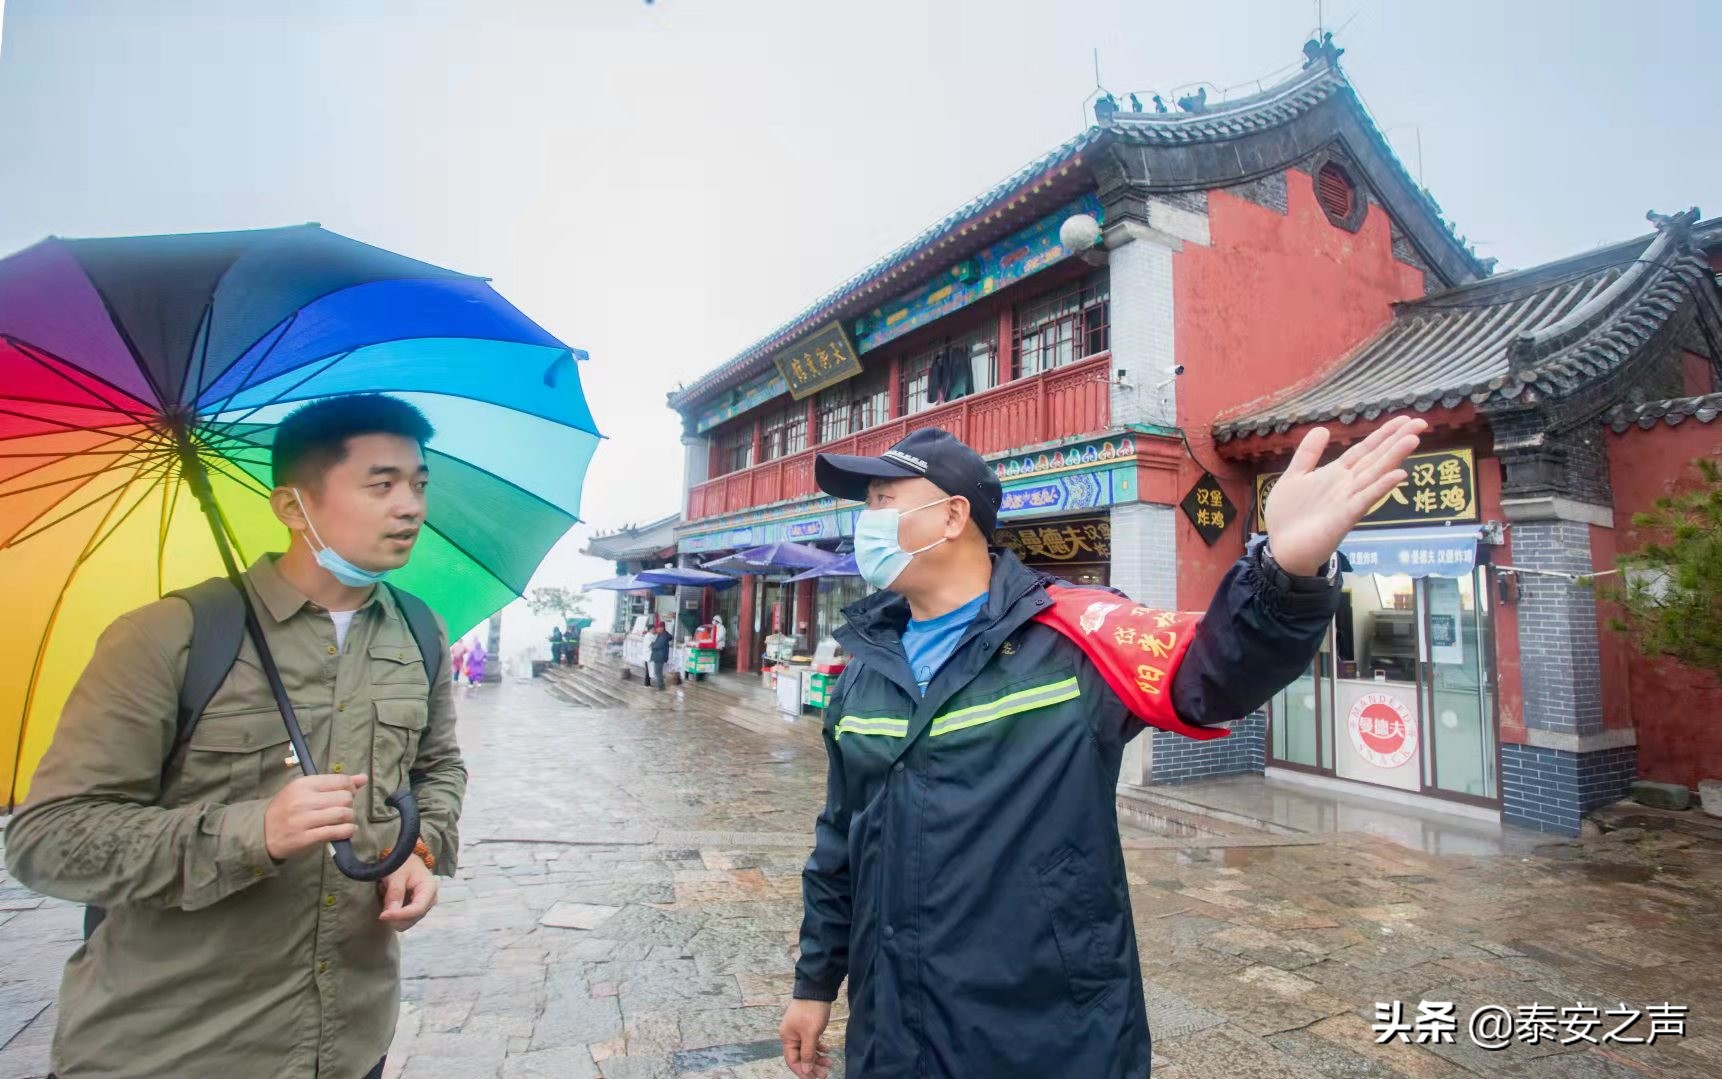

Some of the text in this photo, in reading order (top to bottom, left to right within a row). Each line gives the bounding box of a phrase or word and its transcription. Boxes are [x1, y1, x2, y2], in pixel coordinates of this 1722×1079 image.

[1412, 458, 1462, 486] 汉堡
[1196, 487, 1224, 507] 汉堡
[1413, 485, 1465, 514] 炸鸡
[1196, 509, 1225, 529] 炸鸡
[1019, 528, 1092, 560] 曼德夫
[1359, 716, 1406, 740] 曼德夫
